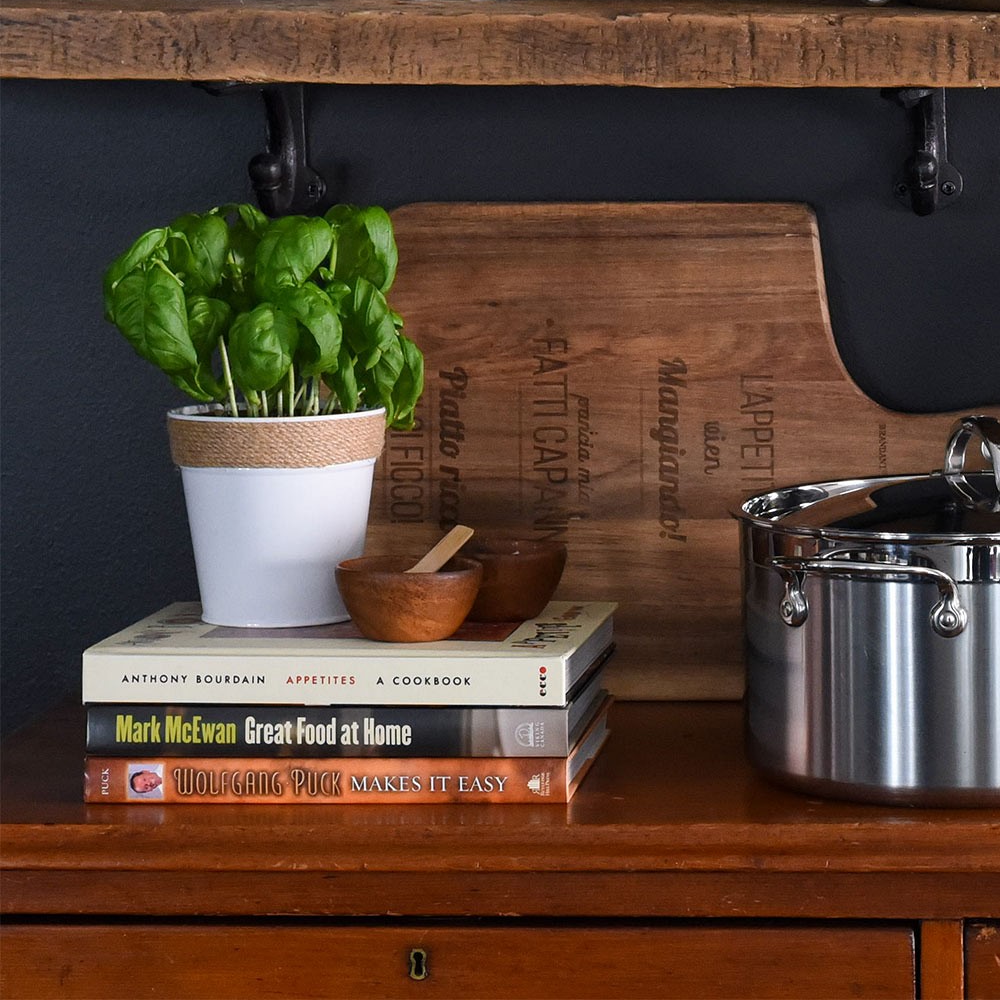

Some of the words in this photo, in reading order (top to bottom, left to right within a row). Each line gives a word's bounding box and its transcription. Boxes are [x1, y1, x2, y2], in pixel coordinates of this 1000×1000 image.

[533, 337, 569, 417] FATTI
[439, 366, 469, 460] Piatto
[740, 374, 775, 492] L'APPETIT
[650, 357, 688, 543] Mangiando!
[704, 420, 727, 475] vien
[390, 446, 425, 524] FICCO!
[121, 674, 188, 684] ANTHONY
[196, 674, 266, 685] BOURDAIN
[286, 675, 356, 685] APPETITES
[376, 676, 384, 686] A
[392, 676, 472, 686] COOKBOOK
[115, 714, 161, 744] Mark
[164, 715, 238, 745] McEwan
[244, 715, 293, 745] Great
[297, 716, 337, 746] Food
[340, 720, 360, 746] at
[363, 717, 413, 746] Home
[101, 768, 110, 796] PUCK
[173, 768, 283, 796] WOLFGANG
[290, 768, 342, 796] PUCK
[350, 775, 422, 793] MAKES
[429, 775, 451, 793] IT
[458, 775, 509, 793] EASY
